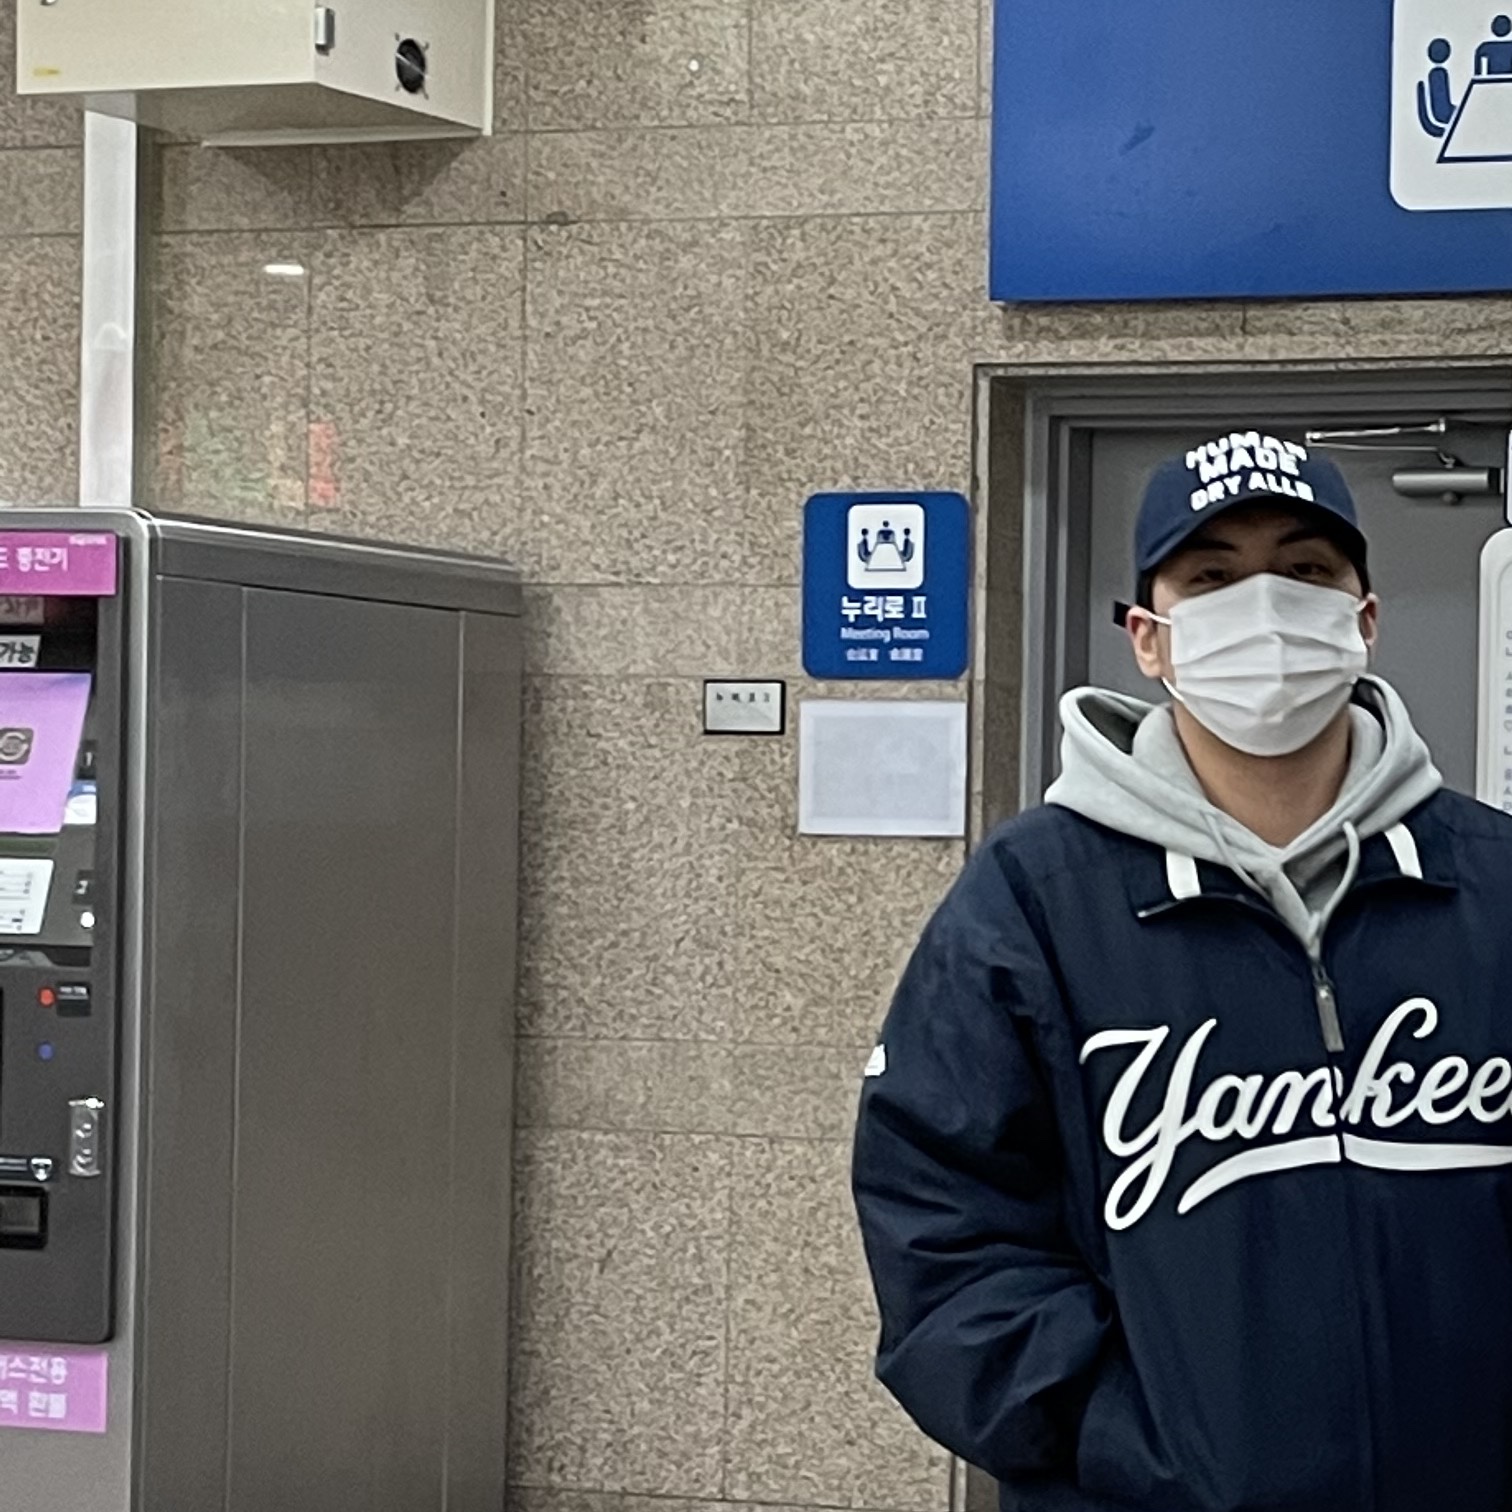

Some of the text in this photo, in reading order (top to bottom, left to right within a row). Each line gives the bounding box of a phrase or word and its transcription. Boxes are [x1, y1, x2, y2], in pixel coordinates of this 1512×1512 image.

[1199, 447, 1300, 483] MADE
[1190, 475, 1242, 512] DRY
[841, 595, 905, 622] 누리로
